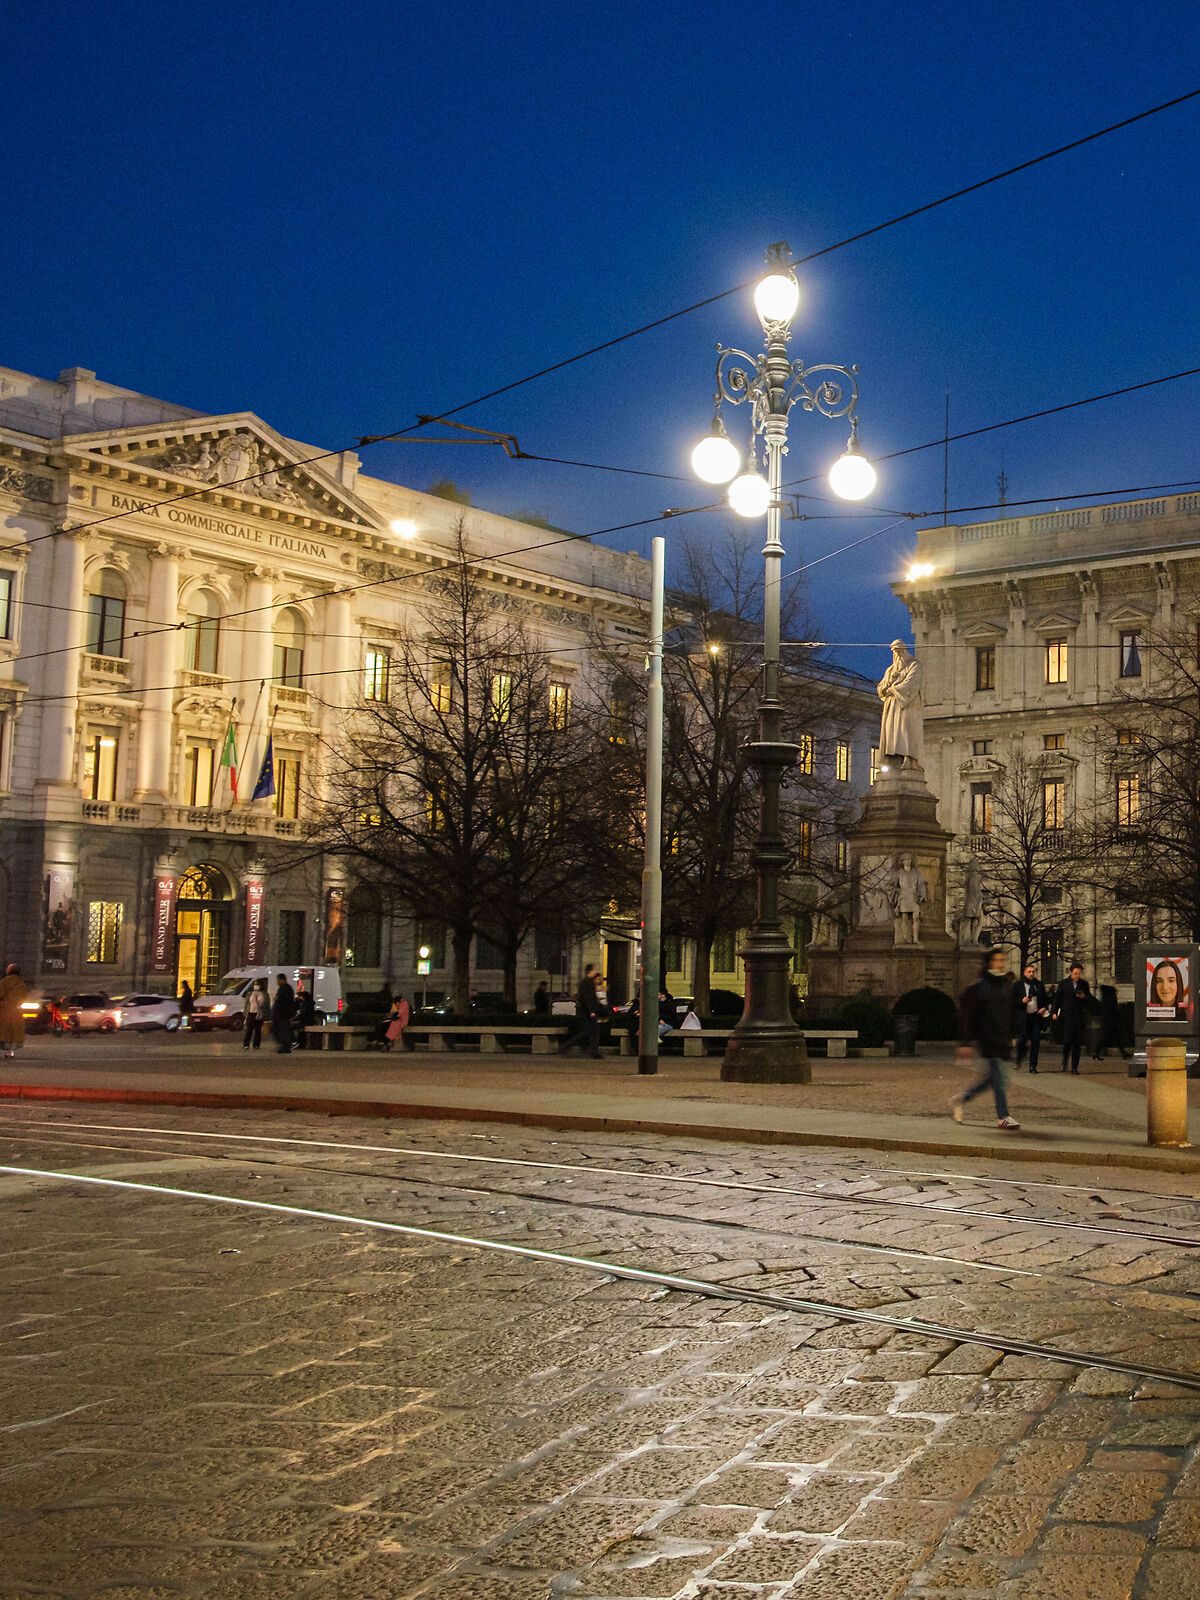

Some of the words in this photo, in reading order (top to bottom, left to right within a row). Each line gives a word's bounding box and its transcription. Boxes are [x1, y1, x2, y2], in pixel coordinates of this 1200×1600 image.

[111, 494, 160, 518] BANCA
[168, 508, 263, 543] COMMERCIALE
[269, 534, 327, 559] ITALIANA
[158, 899, 168, 926] TOUR
[249, 903, 259, 928] TOUR
[156, 926, 166, 960] GRAND
[247, 929, 257, 961] GRAND
